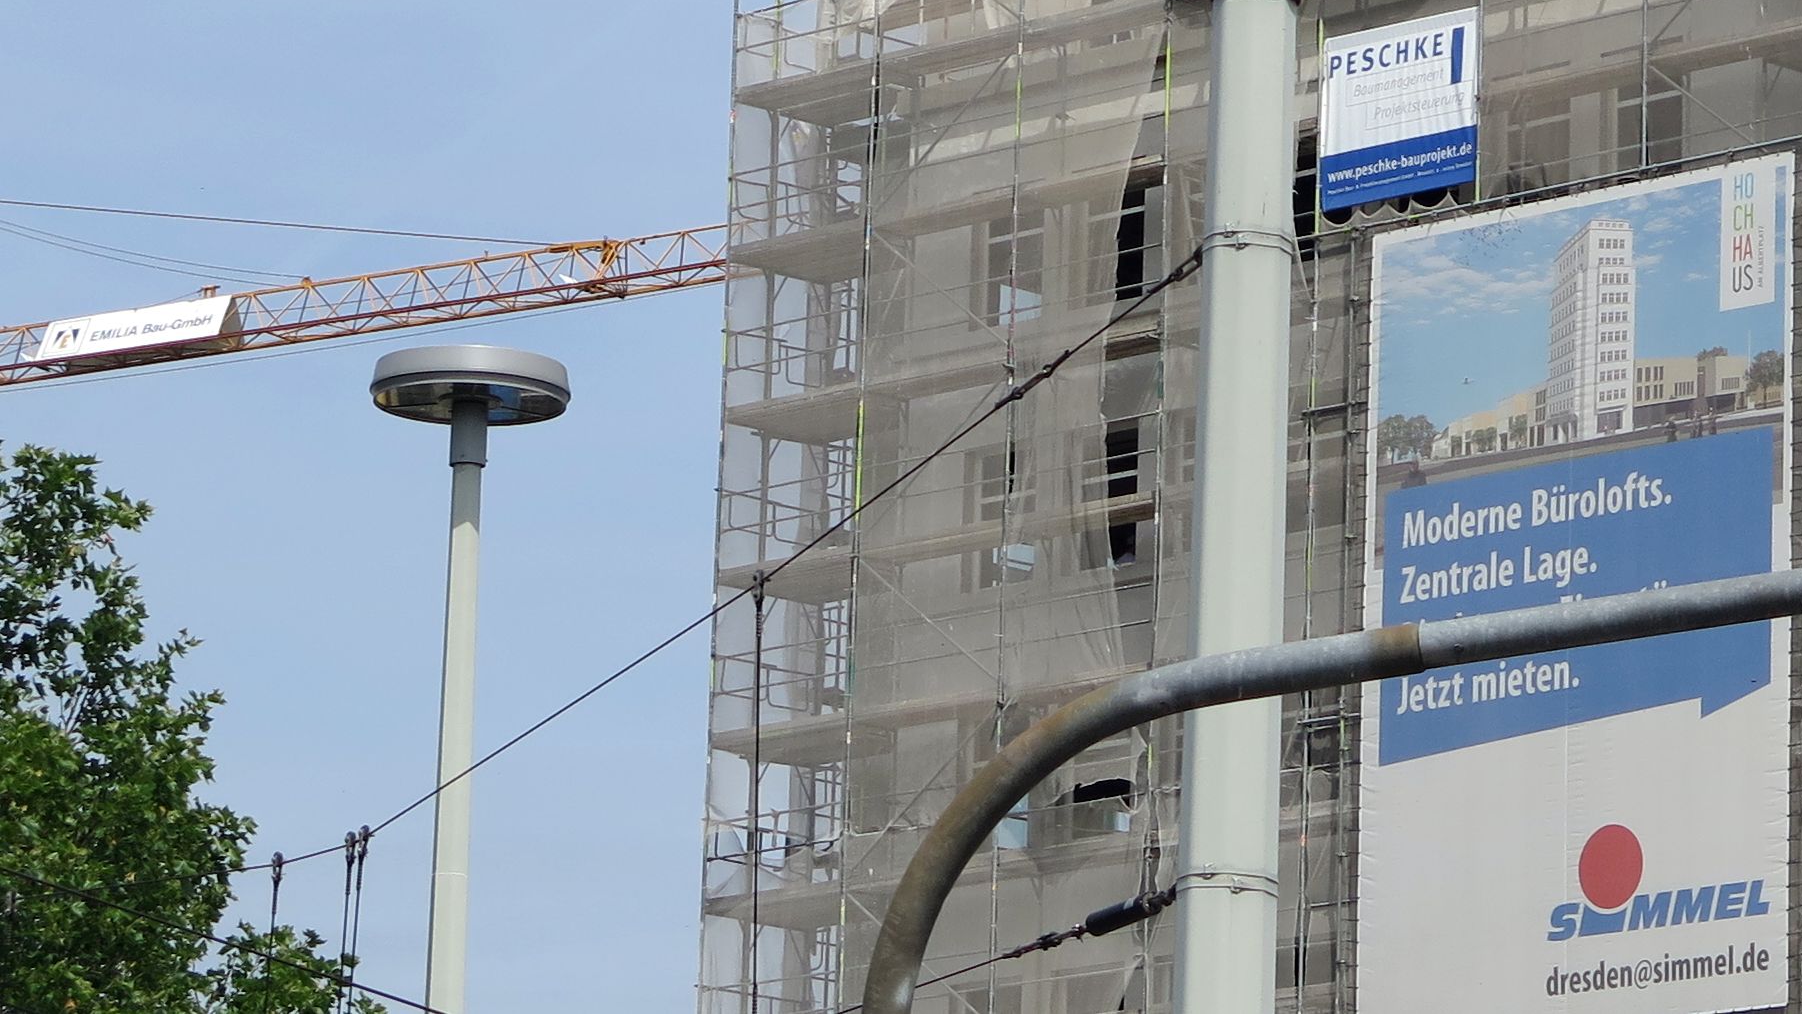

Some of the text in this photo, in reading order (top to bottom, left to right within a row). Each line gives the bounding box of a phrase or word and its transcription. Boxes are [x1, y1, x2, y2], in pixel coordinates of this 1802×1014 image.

[1329, 33, 1444, 78] PESCHKE
[1353, 68, 1445, 98] Baumanagement
[1374, 91, 1465, 120] Projektsteuerung
[1327, 142, 1473, 183] www.peschke-bauprojekt.de
[1734, 173, 1754, 201] HO
[1733, 203, 1754, 231] CH
[1733, 233, 1753, 262] HA
[1733, 264, 1754, 293] US
[90, 314, 213, 342] EMILIA Bau-GmbH
[1402, 471, 1673, 549] Moderne Bürolofts.
[1400, 548, 1514, 604] Zentrale
[1523, 545, 1598, 588] Lage.
[1396, 659, 1580, 715] Jetzt mieten.
[1547, 879, 1771, 941] SIMMEL
[1546, 943, 1770, 996] dresden@simmel.de
